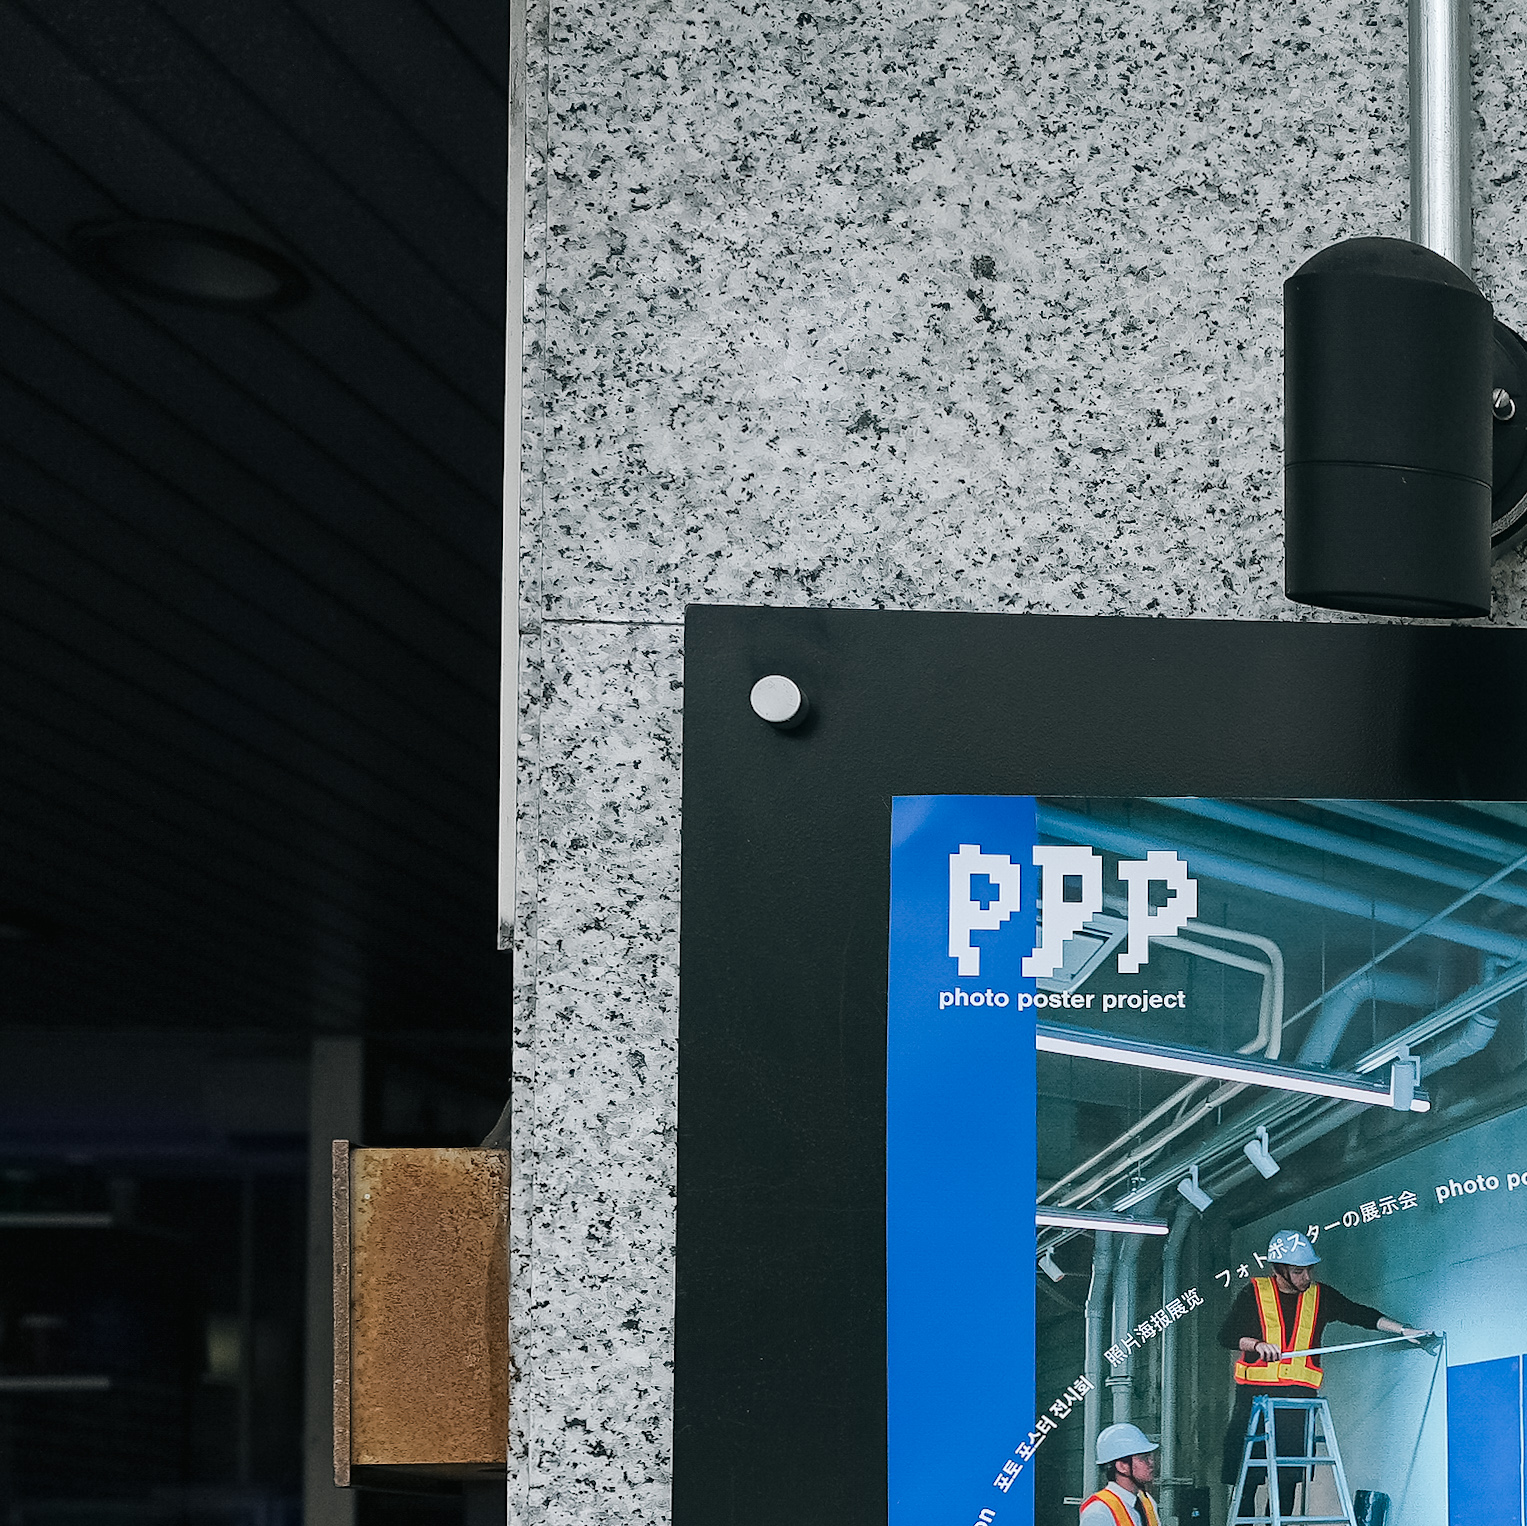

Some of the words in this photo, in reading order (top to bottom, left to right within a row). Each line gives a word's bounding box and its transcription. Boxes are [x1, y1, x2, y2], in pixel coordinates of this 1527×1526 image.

[938, 987, 1010, 1010] photo
[1017, 990, 1096, 1011] poster
[1102, 989, 1186, 1012] project
[1434, 1172, 1500, 1204] photo
[1214, 1189, 1419, 1288] フォトポスターの展示会
[1103, 1286, 1205, 1368] 照片海报展览
[993, 1459, 1023, 1493] 포토
[1015, 1414, 1058, 1462] 포스터
[1049, 1374, 1095, 1420] 전시회
